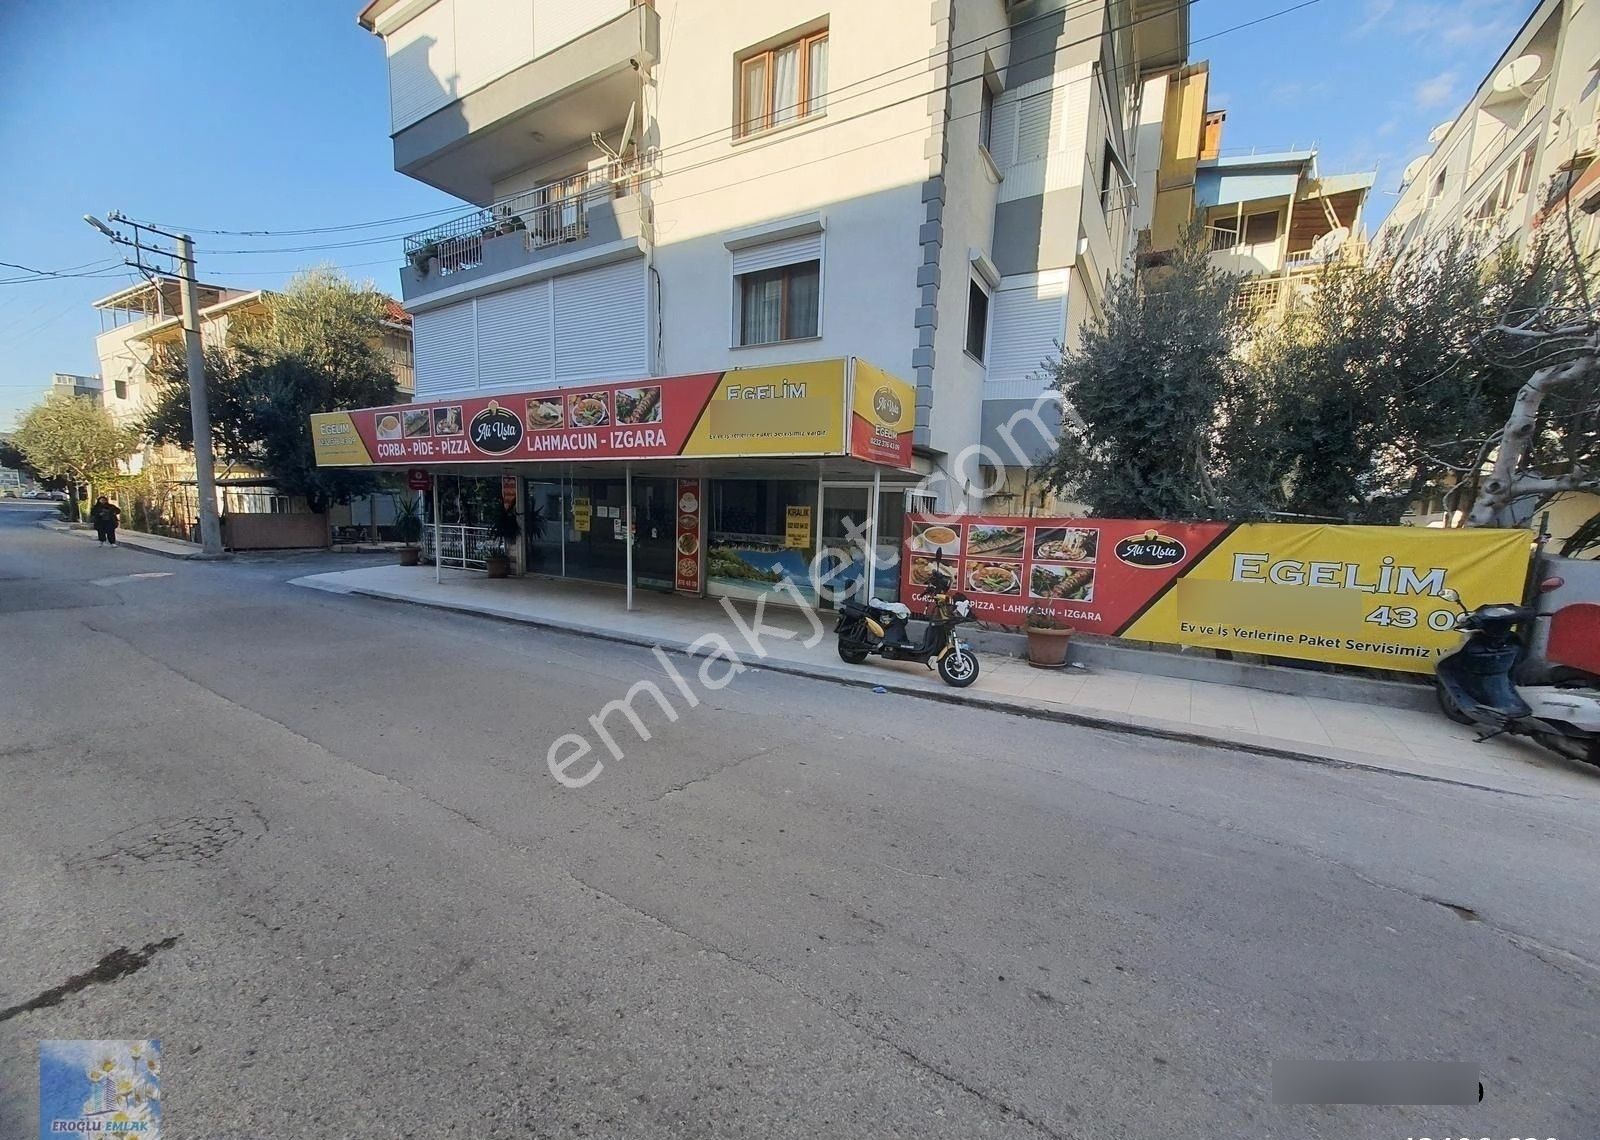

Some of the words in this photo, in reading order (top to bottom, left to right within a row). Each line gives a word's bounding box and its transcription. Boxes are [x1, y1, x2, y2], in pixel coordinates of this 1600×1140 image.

[476, 422, 491, 442] Ali
[492, 421, 517, 440] Usta
[526, 432, 598, 452] LAHMACUN
[610, 428, 667, 449] IZGARA
[377, 443, 407, 458] ÇORBA
[413, 439, 434, 456] PİDE
[441, 437, 471, 454] PİZZA
[1122, 544, 1145, 557] Ali
[1146, 544, 1177, 559] Usta
[1231, 552, 1448, 597] EGELİM
[1063, 608, 1102, 622] IZGARA
[1365, 605, 1418, 628] 43
[1427, 609, 1472, 632] 0
[1180, 622, 1195, 633] Ev
[1200, 625, 1214, 635] ve
[1217, 623, 1228, 638] İş
[1232, 627, 1294, 643] Yerlerine
[1298, 634, 1341, 649] Paket
[1345, 639, 1430, 658] Servisimiz
